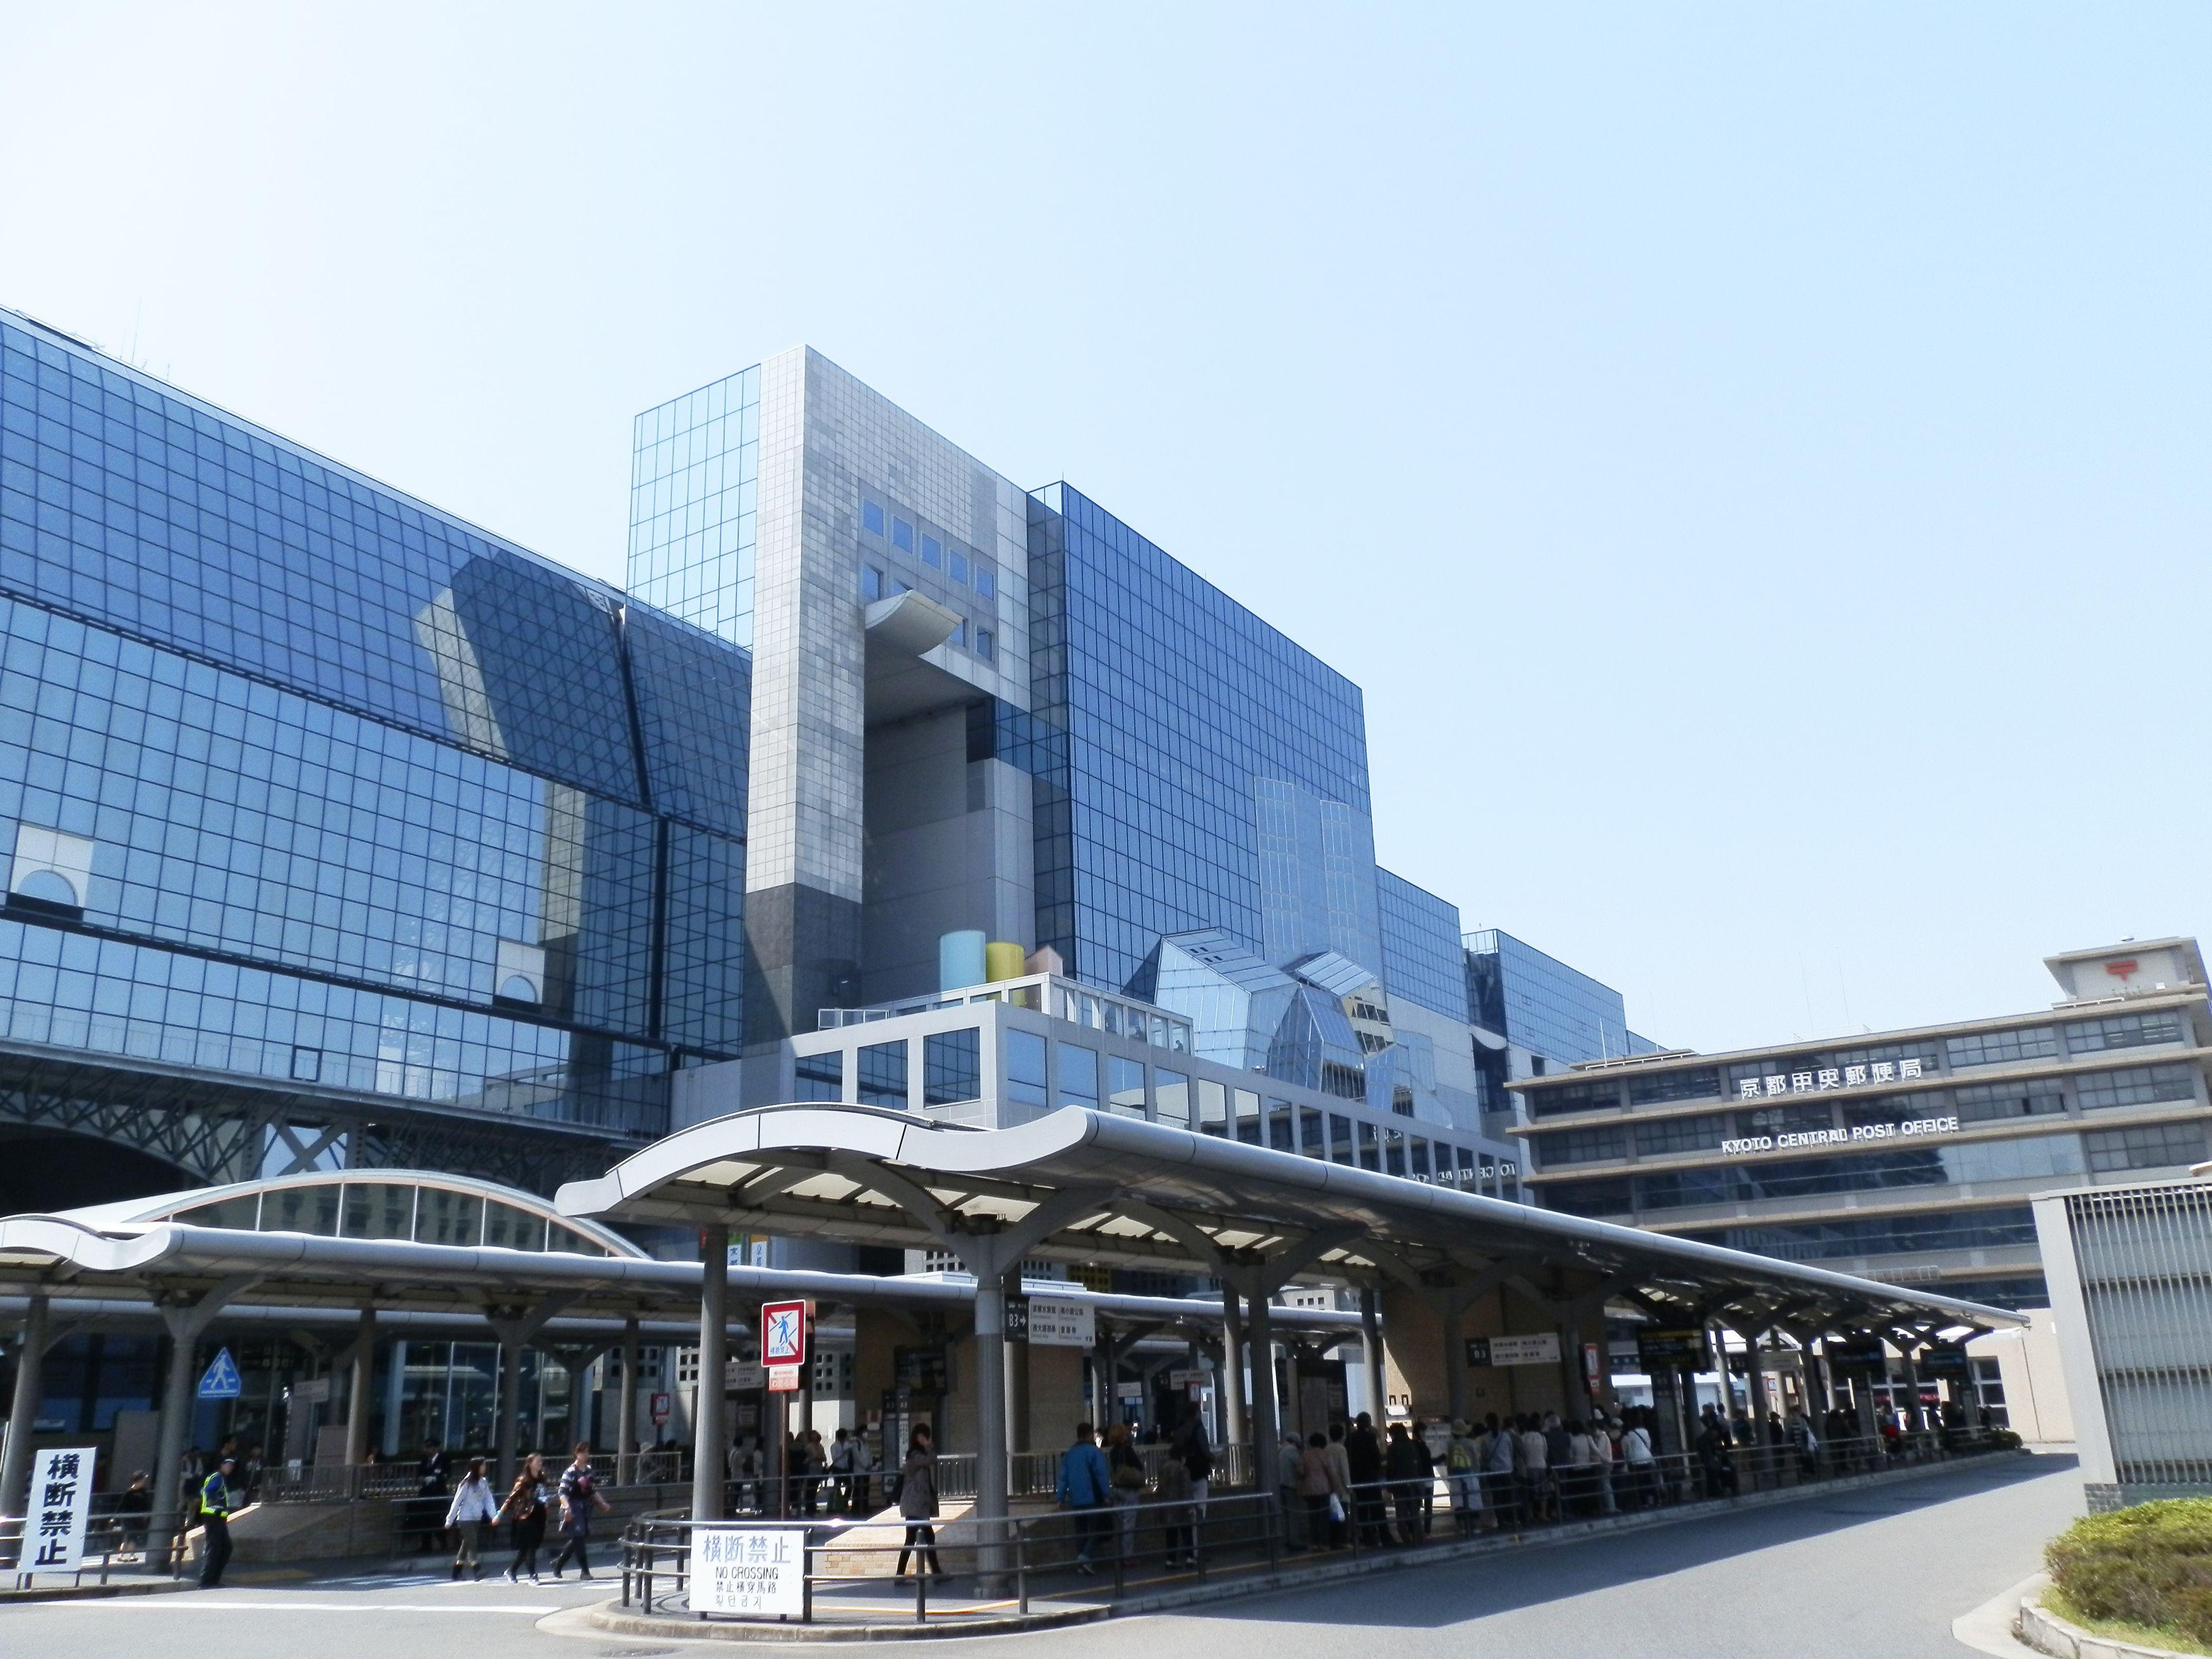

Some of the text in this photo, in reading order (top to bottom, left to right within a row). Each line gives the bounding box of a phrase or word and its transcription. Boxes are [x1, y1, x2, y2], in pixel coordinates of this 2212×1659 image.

[1740, 1058, 1922, 1099] 京都中央郵便局
[1721, 1116, 1959, 1154] KYOTO CENTRAL POST OFFICE
[35, 1453, 80, 1566] 横断禁止
[703, 1535, 791, 1563] 横断禁止
[715, 1566, 778, 1580] NO CROSSING
